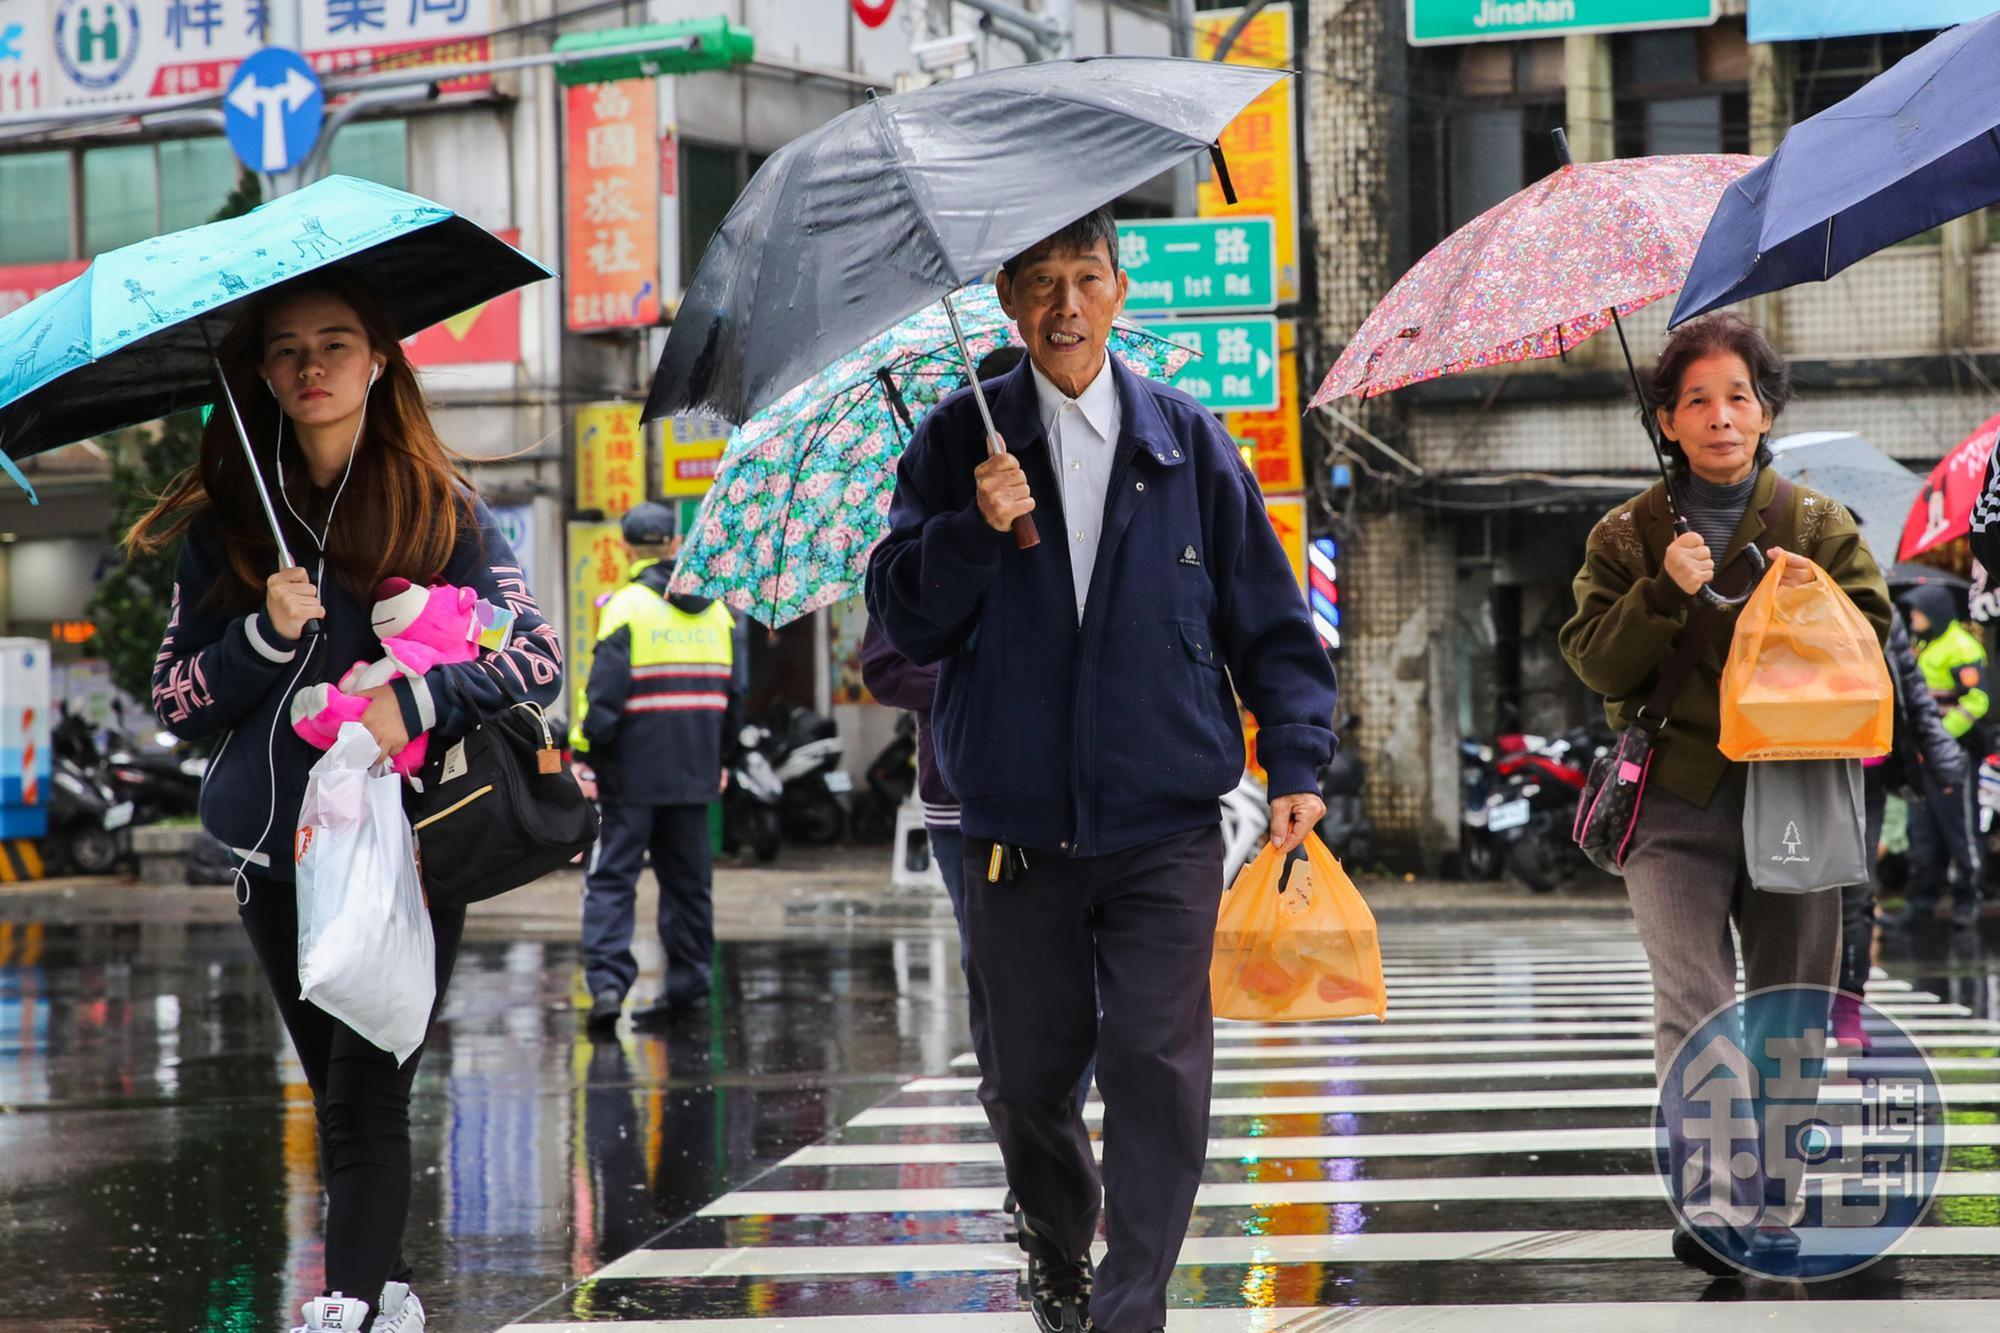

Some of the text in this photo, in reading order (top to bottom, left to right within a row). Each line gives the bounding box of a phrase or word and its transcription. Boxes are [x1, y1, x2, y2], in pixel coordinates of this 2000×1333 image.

[1473, 0, 1576, 27] Jinshan
[1118, 228, 1252, 268] 忠一路
[1184, 275, 1212, 297] 1st
[1224, 273, 1253, 296] Rd.
[1222, 375, 1254, 397] Rd.
[321, 1321, 342, 1329] FILA
